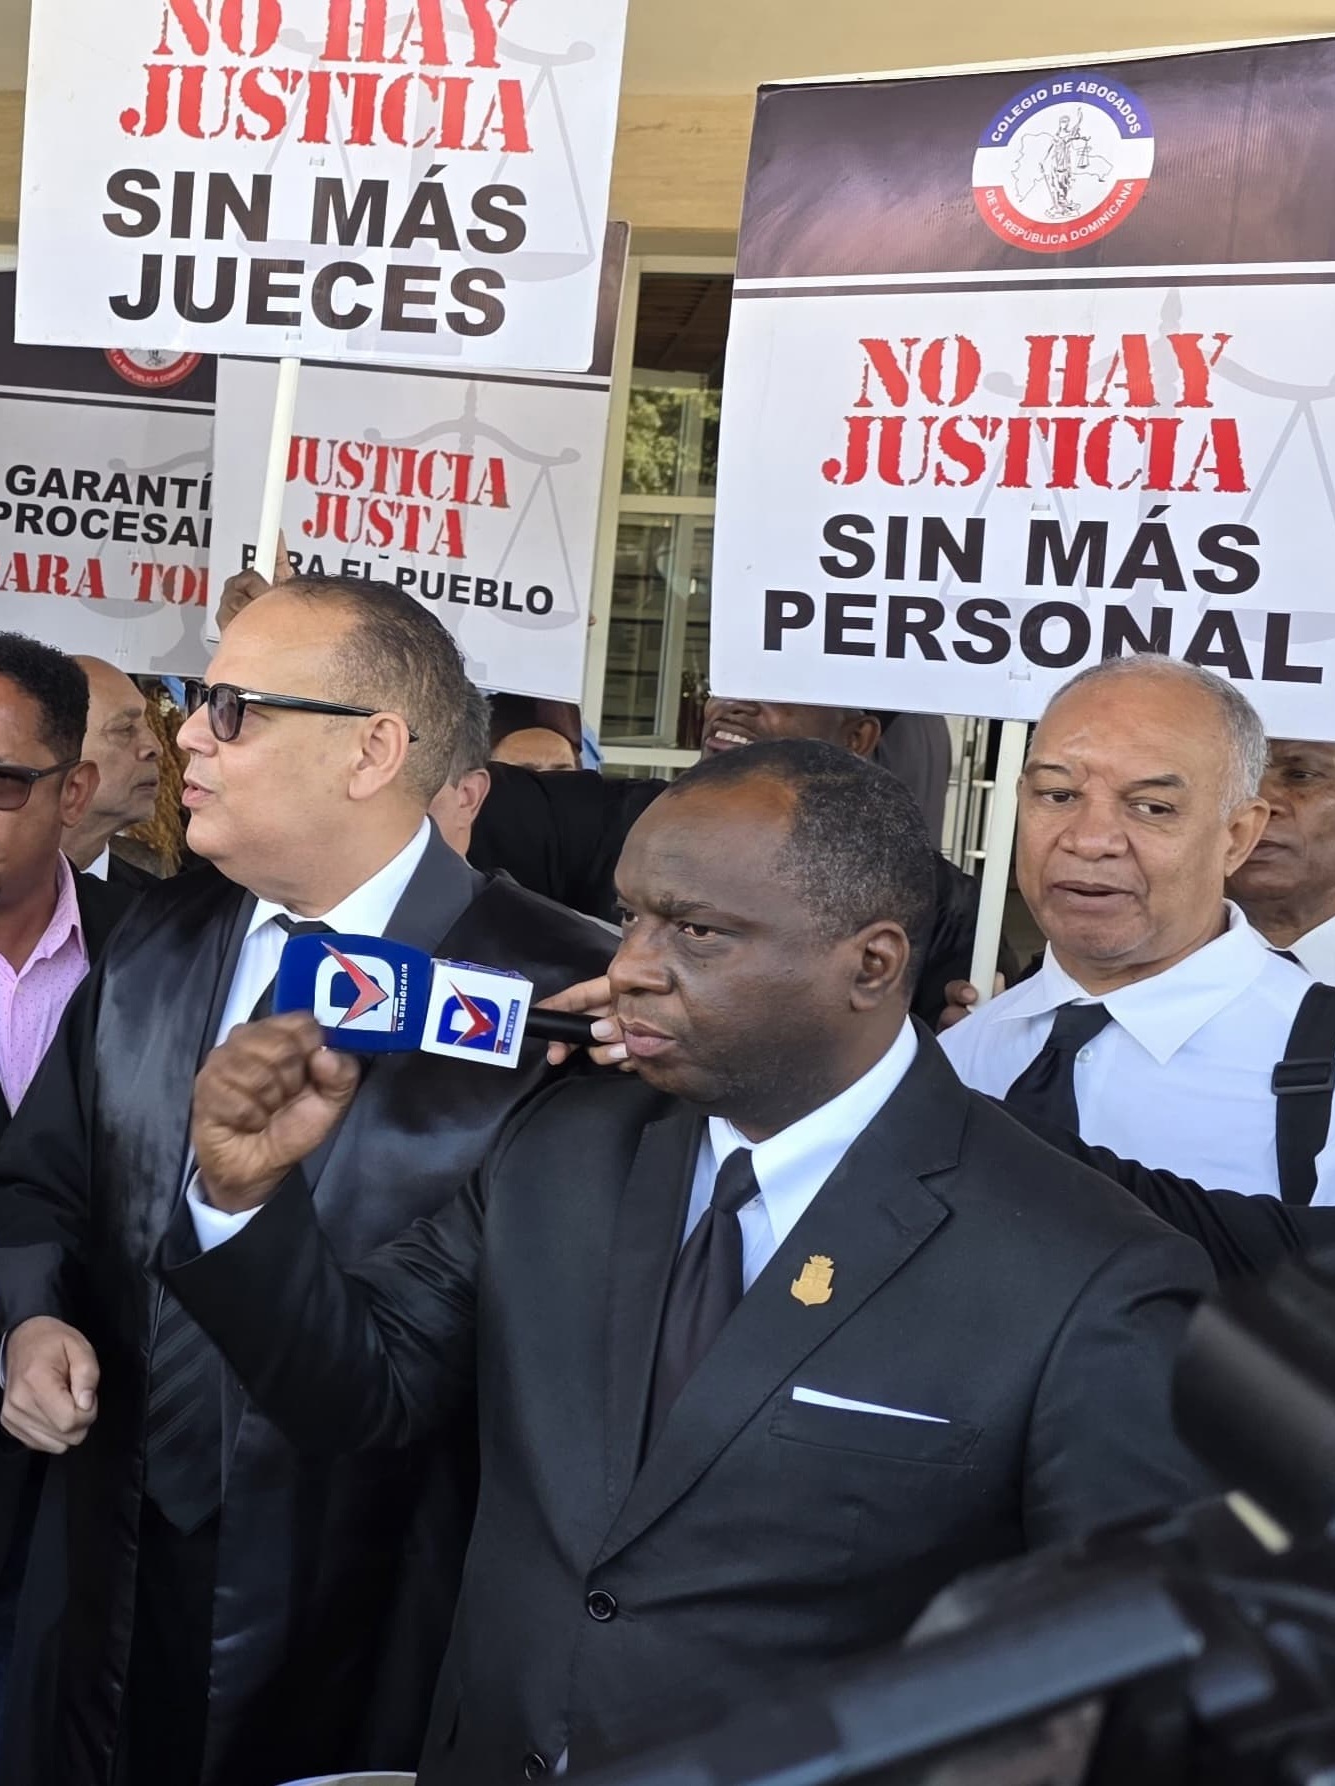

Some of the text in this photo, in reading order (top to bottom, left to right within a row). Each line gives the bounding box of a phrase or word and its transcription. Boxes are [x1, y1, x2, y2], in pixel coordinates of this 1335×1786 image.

[152, 0, 517, 69] NO HAY
[119, 64, 533, 153] JUSTICIA
[991, 81, 1141, 142] COLEGIO DE ABOGADOS
[102, 164, 528, 254] SIN MÁS
[985, 181, 1135, 244] DE LA REPÚBLICA DOMINICANA
[108, 254, 507, 338] JUECES
[853, 332, 1232, 408] NO HAY
[5, 464, 213, 511] GARANTÍ
[285, 435, 511, 508] JUSTICIA
[822, 415, 1251, 493] JUSTICIA
[302, 492, 467, 559] JUSTA
[819, 504, 1261, 595] SIN MÁS
[242, 544, 326, 577] PRA
[396, 566, 554, 615] PUEBLO
[763, 589, 1324, 684] PERSONAL
